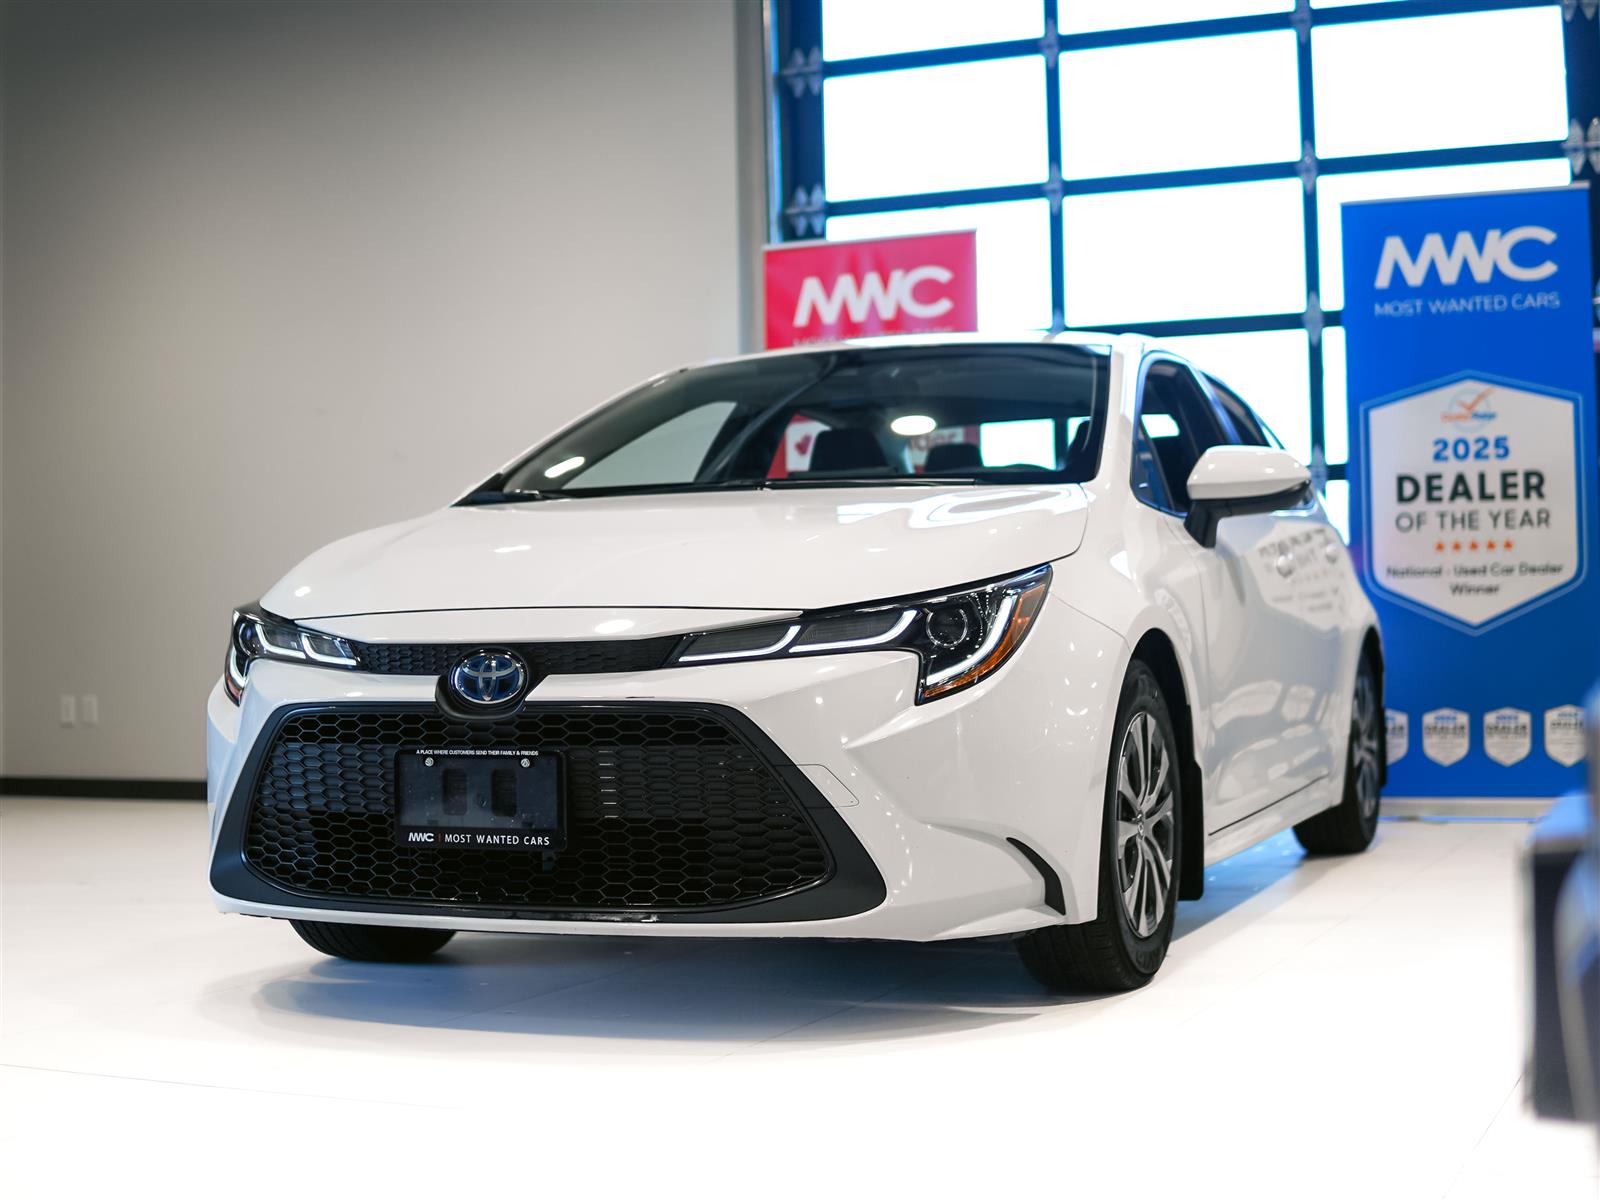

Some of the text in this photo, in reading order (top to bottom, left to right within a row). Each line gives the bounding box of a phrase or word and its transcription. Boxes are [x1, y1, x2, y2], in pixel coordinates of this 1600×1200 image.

[1374, 225, 1559, 289] MWC
[793, 265, 954, 327] MWC
[1374, 291, 1561, 317] MOST WANTED CARS
[1433, 436, 1510, 462] 2025
[1396, 470, 1546, 504] DEALER
[1395, 507, 1551, 533] OF THE YEAR
[1386, 561, 1563, 578] National Used Car Dealer
[1450, 583, 1500, 596] Winner
[408, 832, 550, 846] MWC MOST WANTED CARS
